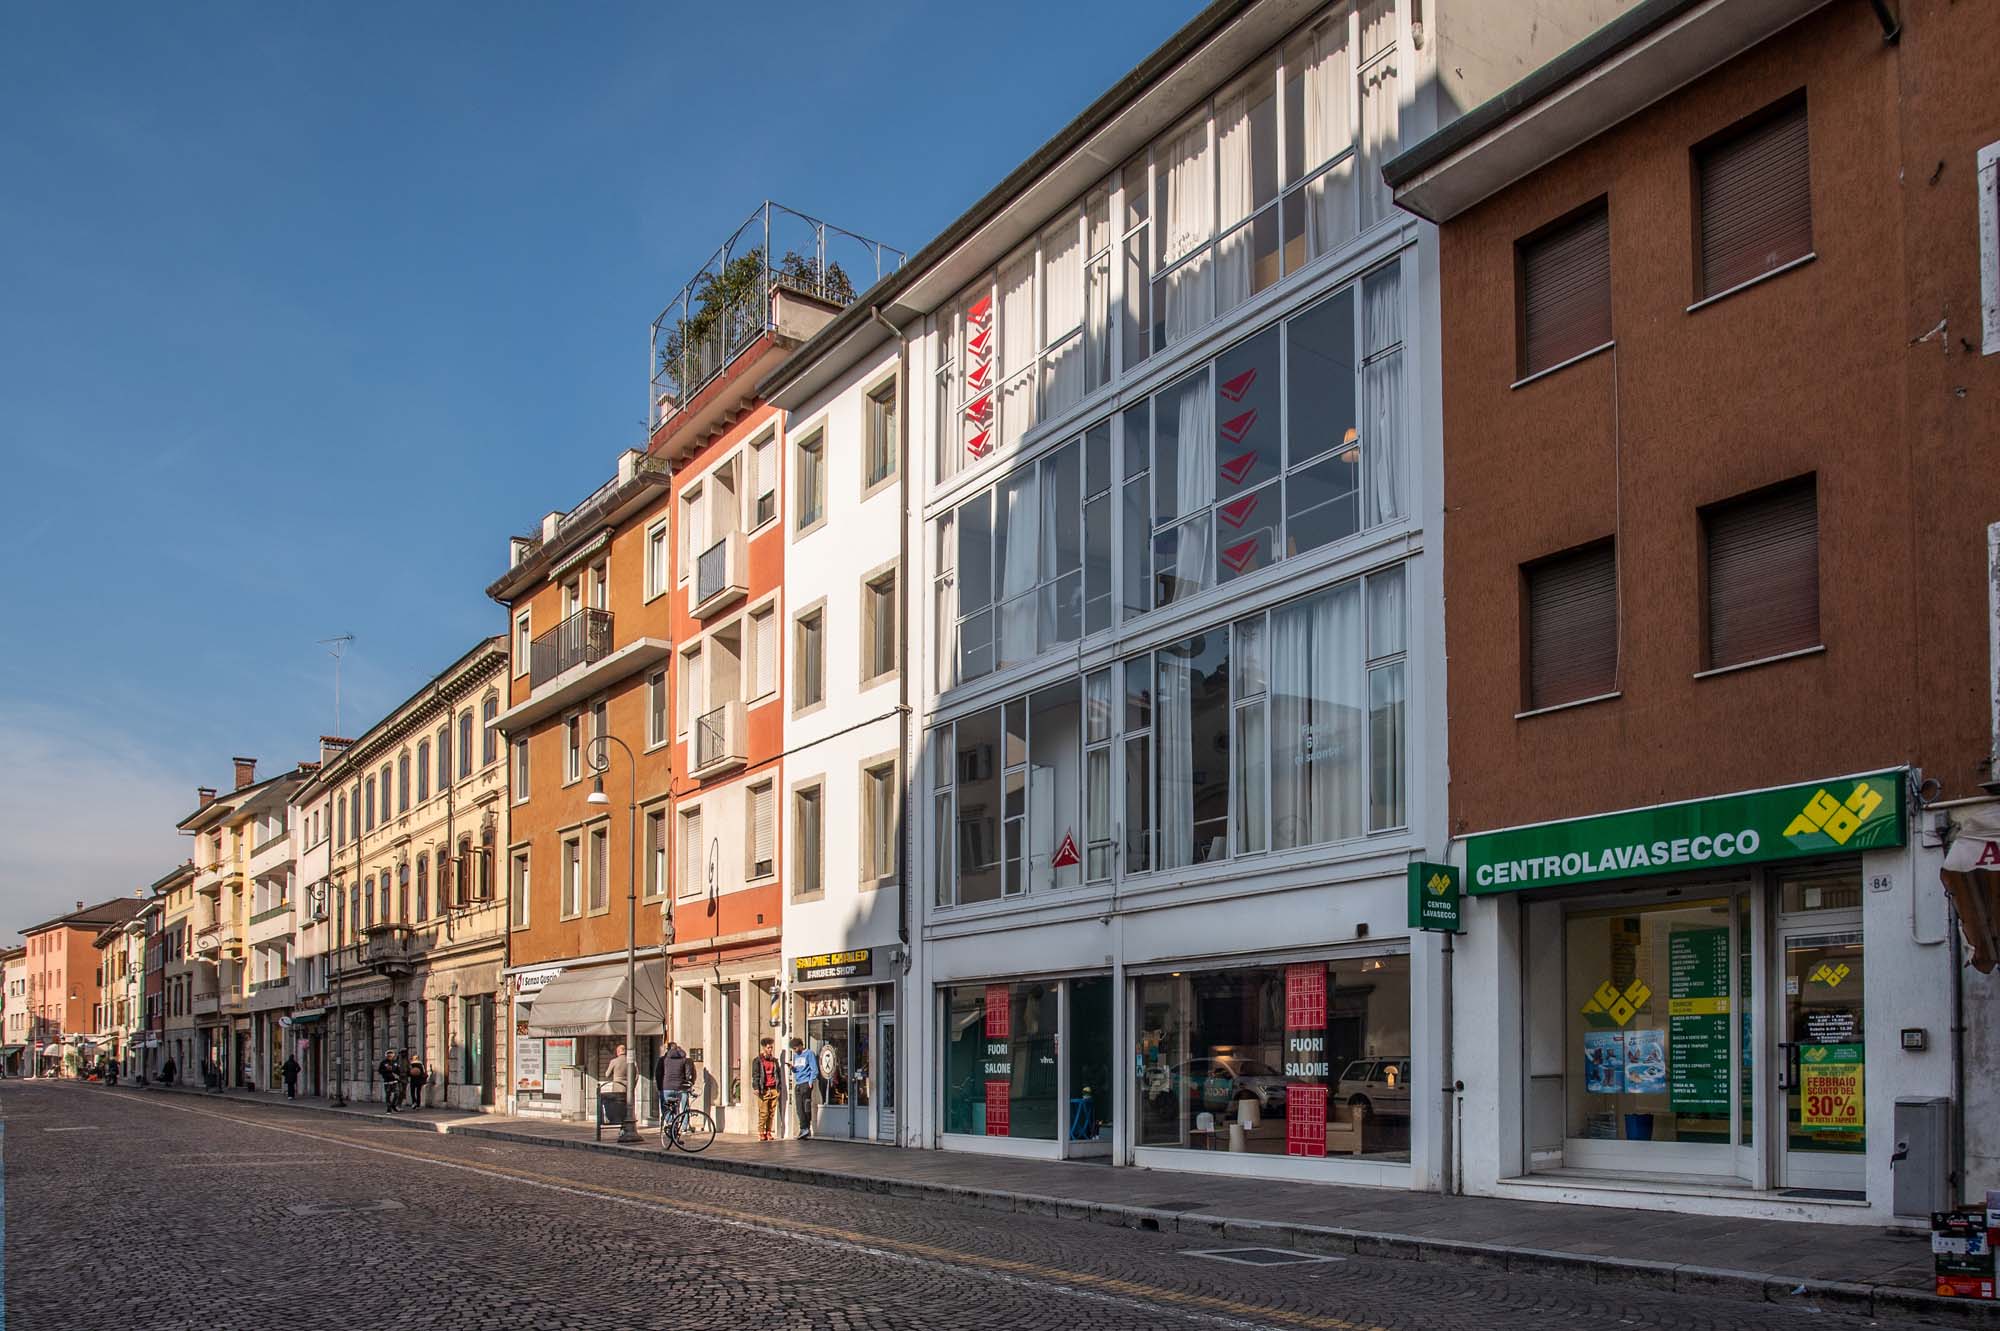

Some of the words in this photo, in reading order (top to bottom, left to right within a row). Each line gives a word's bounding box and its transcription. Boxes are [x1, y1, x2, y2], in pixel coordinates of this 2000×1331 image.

[1476, 829, 1760, 886] CENTROLAVASECCO
[1873, 877, 1888, 889] 84
[1427, 900, 1451, 910] CENTRO
[1423, 909, 1456, 919] LAVASECCO
[987, 1043, 1008, 1055] FUORI
[1290, 1038, 1324, 1052] FUORI
[984, 1063, 1011, 1074] SALONE
[1285, 1062, 1329, 1076] SALONE
[1807, 1077, 1856, 1087] FEBBRAIO
[1807, 1087, 1839, 1095] SCONTO
[1841, 1087, 1855, 1095] DEL
[1807, 1095, 1856, 1117] 30%
